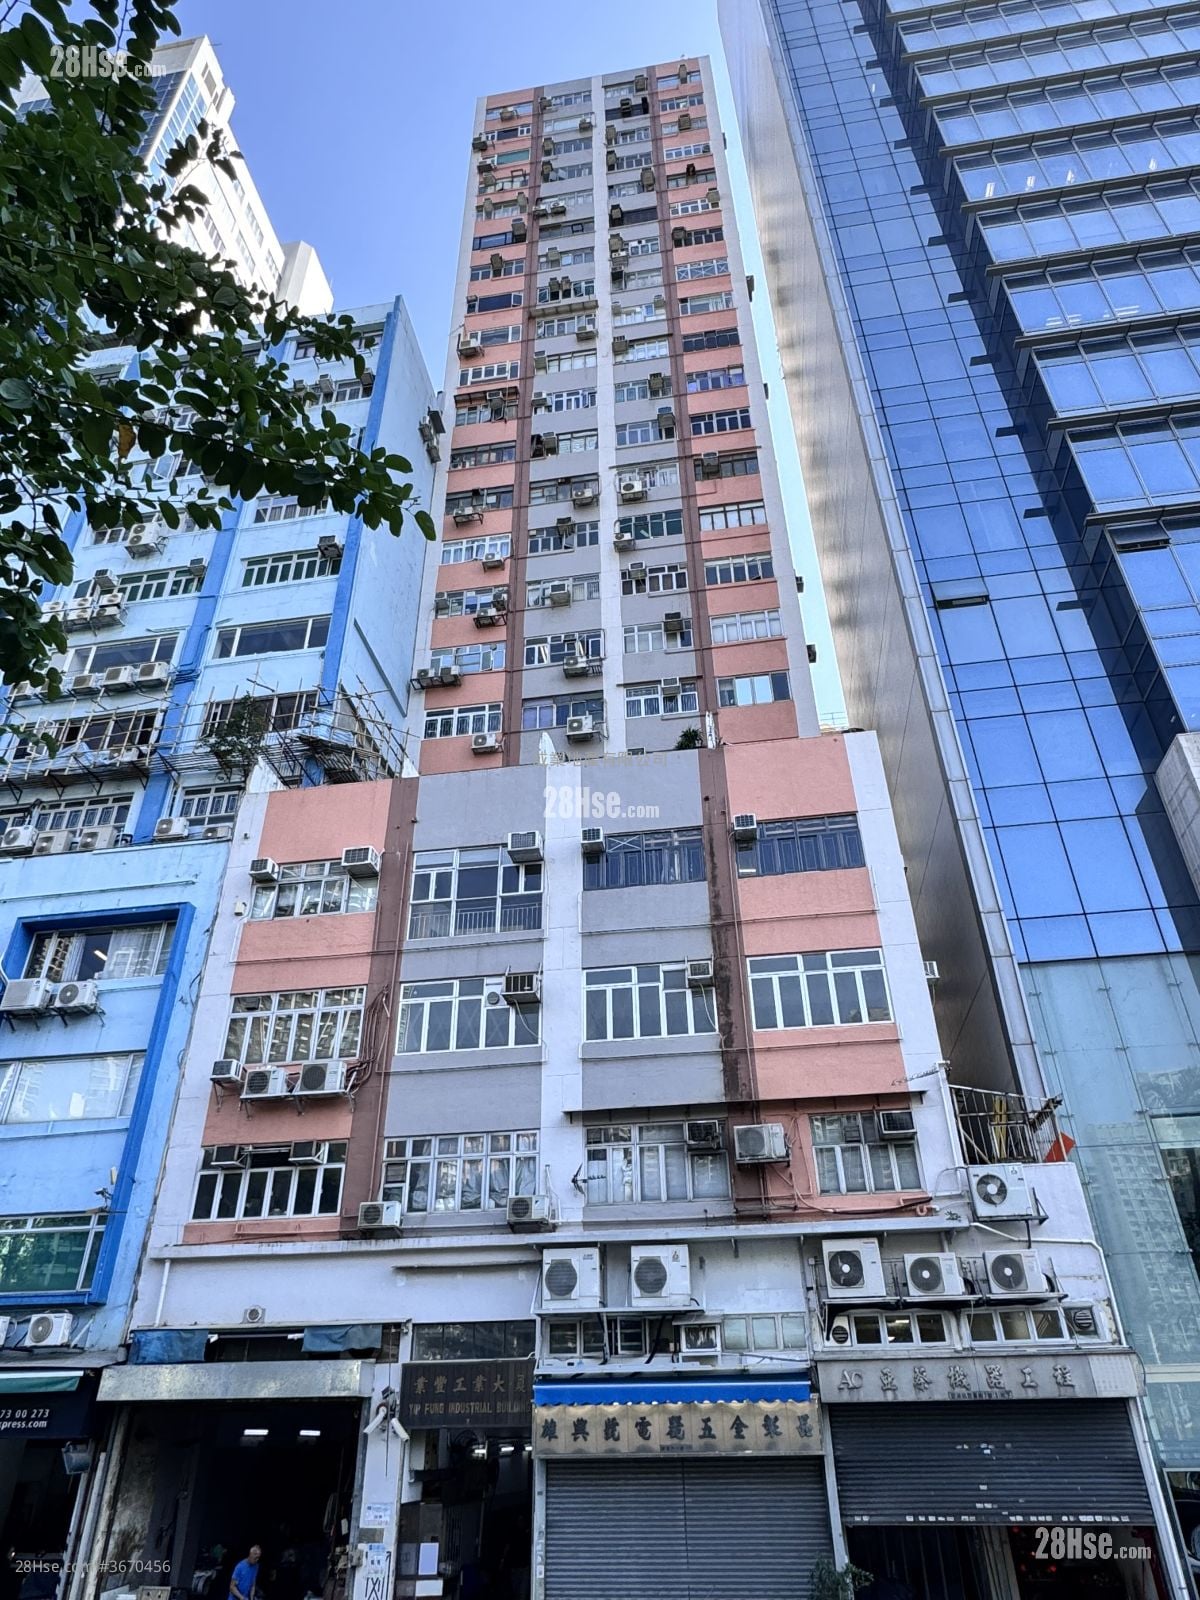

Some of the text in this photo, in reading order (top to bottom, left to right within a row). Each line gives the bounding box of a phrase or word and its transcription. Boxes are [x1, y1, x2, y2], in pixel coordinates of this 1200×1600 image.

[15, 1409, 28, 1419] 00
[31, 1408, 50, 1418] 273
[424, 1403, 444, 1415] FUNG
[448, 1402, 492, 1414] INDUSTRIAL
